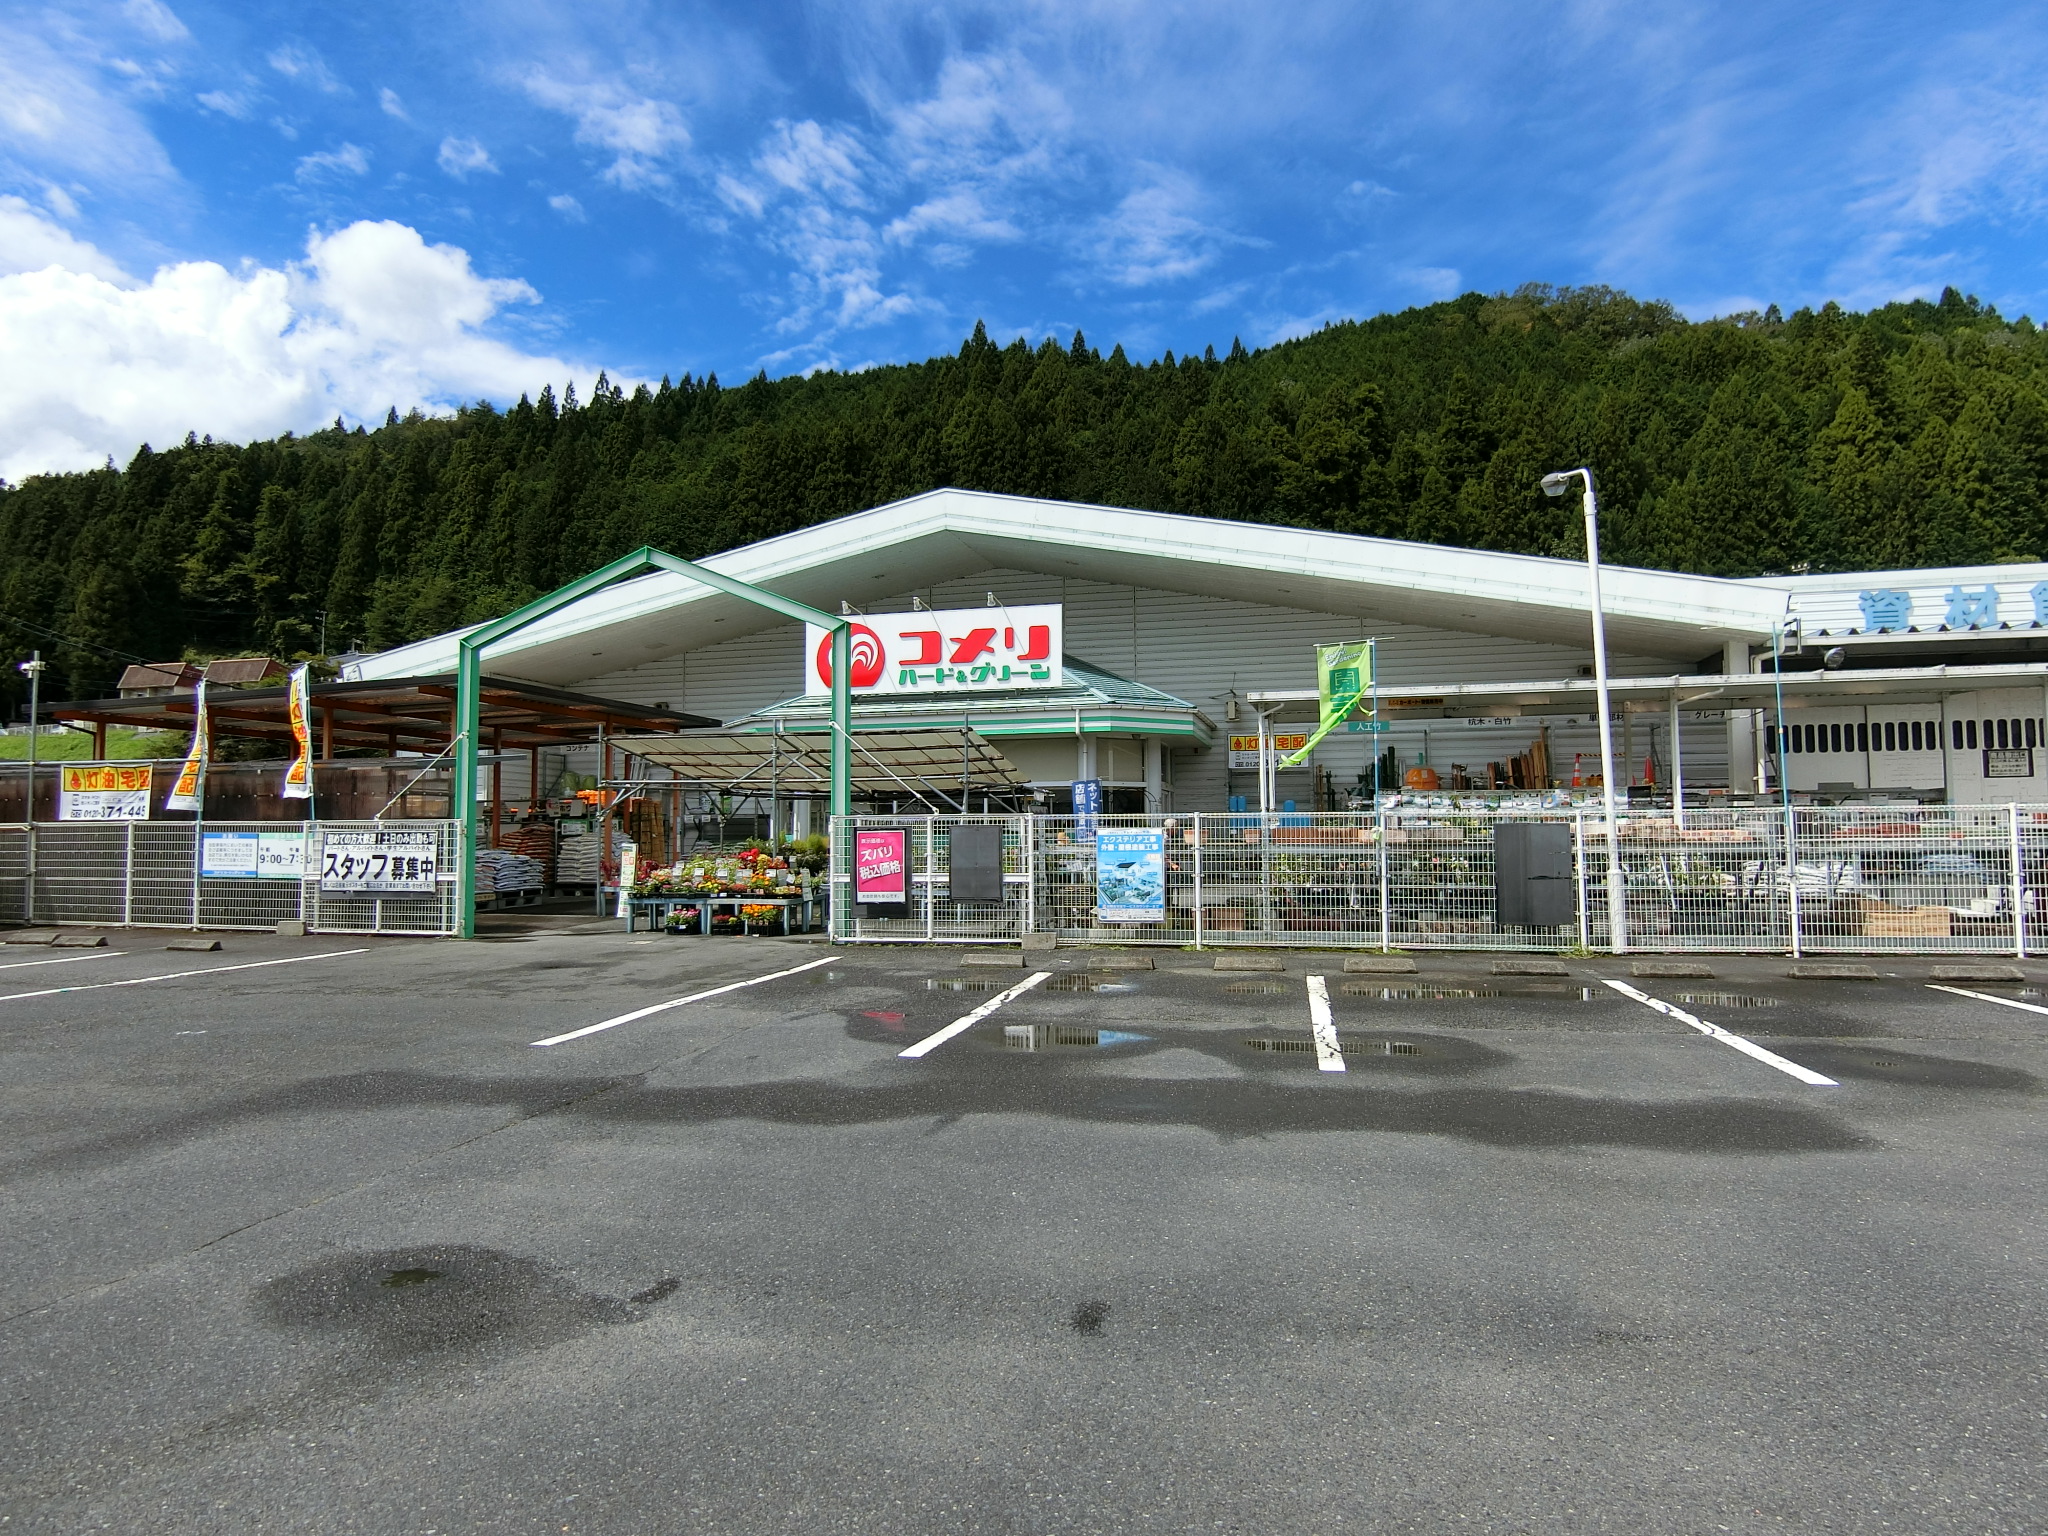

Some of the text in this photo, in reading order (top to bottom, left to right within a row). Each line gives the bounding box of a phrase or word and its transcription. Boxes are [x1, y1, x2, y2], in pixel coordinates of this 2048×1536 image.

[899, 624, 1050, 666] コメリ
[899, 661, 1050, 685] ハード&グリーン
[1588, 712, 1625, 722] 単部材
[1246, 737, 1304, 749] 灯宅配
[859, 860, 902, 880] 税込価格
